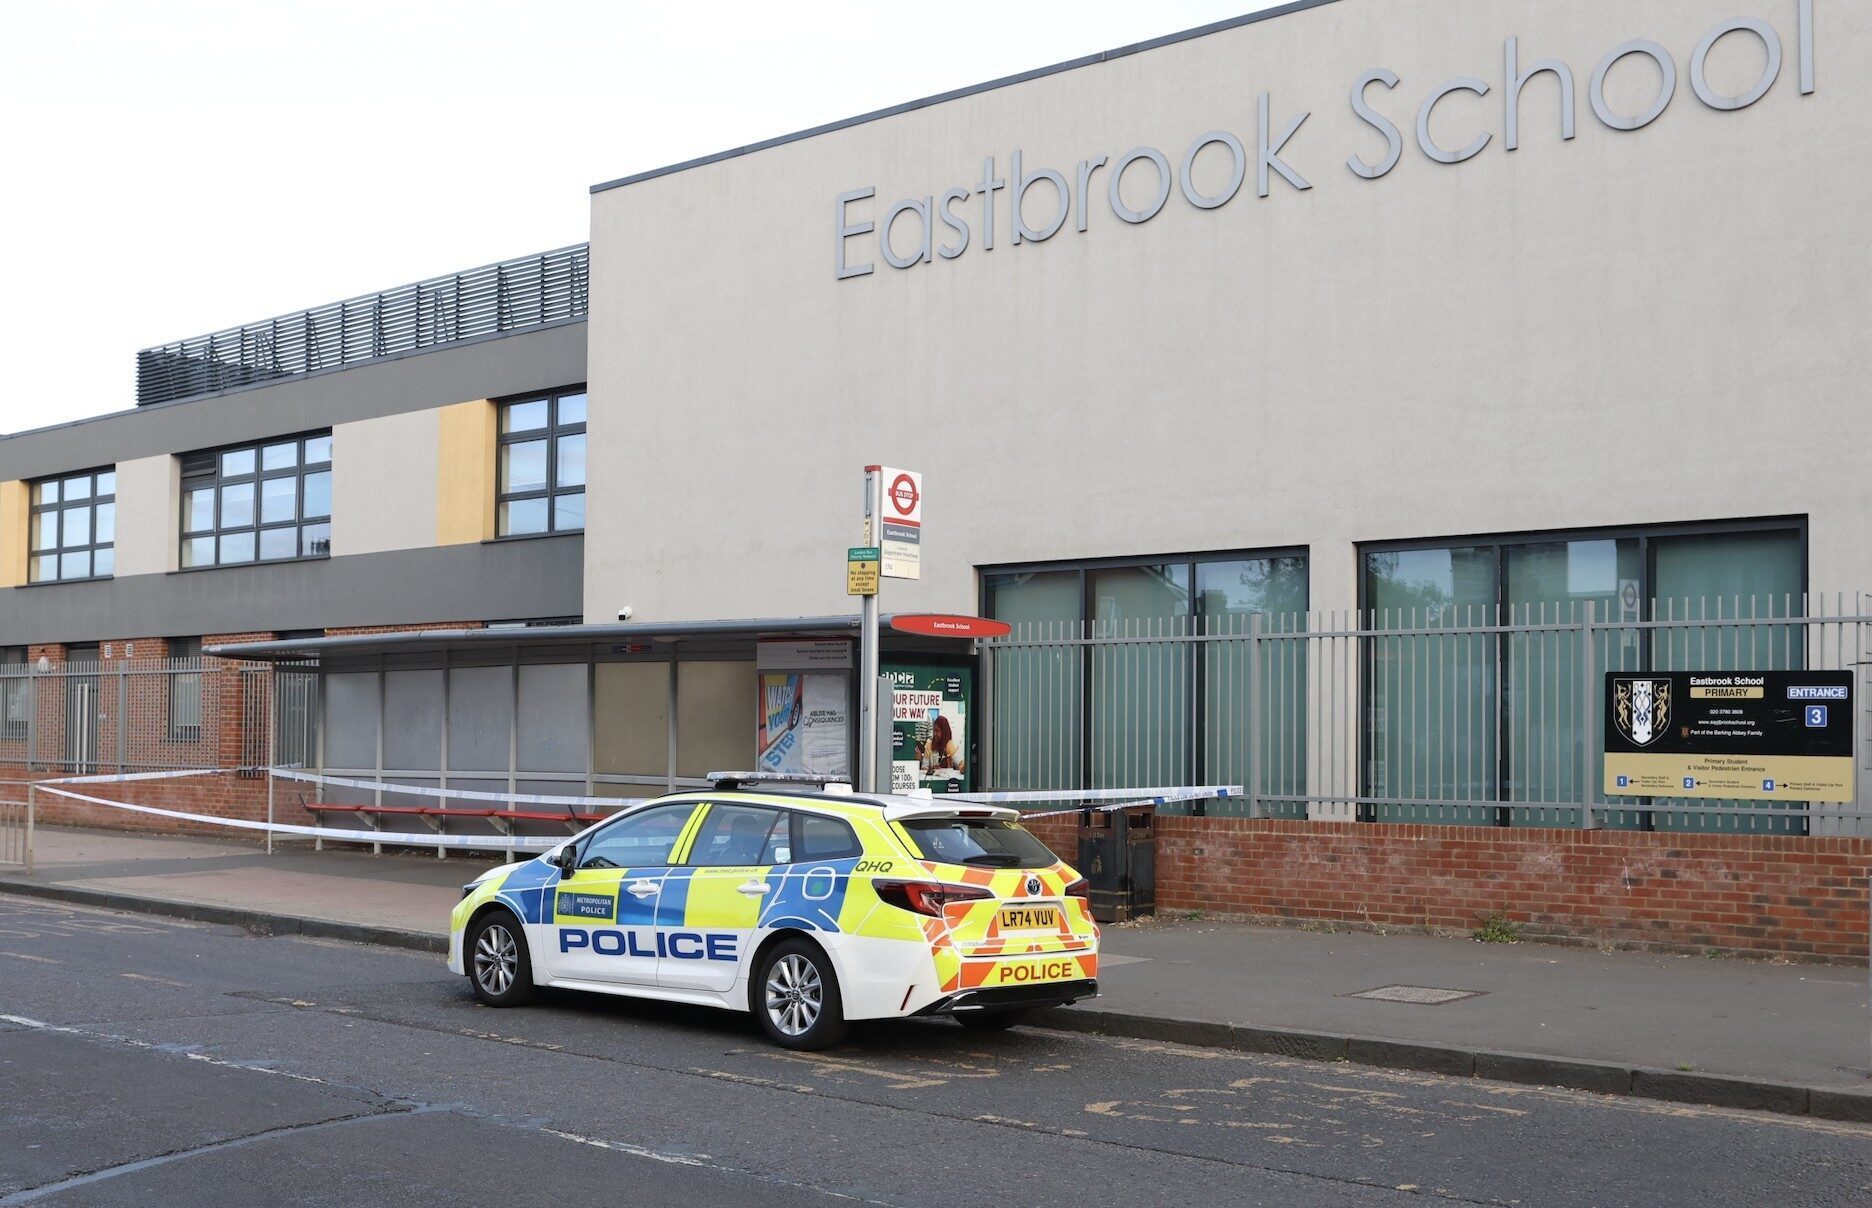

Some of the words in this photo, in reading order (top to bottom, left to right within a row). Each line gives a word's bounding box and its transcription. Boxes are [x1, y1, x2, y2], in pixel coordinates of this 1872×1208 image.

[835, 92, 1312, 280] Eastbrook
[1346, 0, 1814, 178] School
[887, 529, 905, 537] Eastbrook
[906, 531, 917, 539] School
[1690, 677, 1732, 685] Eastbrook
[1734, 677, 1764, 685] School
[767, 686, 795, 710] WATCH
[1705, 688, 1748, 696] PRIMARY
[1790, 688, 1845, 697] ENTRANCE
[893, 694, 907, 705] UR
[910, 694, 940, 706] FUTURE
[768, 704, 792, 731] YOUR
[893, 708, 907, 719] UR
[910, 708, 925, 719] WAY
[1811, 709, 1822, 724] 3
[766, 733, 795, 766] STEP
[892, 782, 916, 790] COURSES
[856, 861, 893, 873] QHQ
[576, 897, 612, 906] METROPOLITAN
[580, 907, 606, 915] POLICE
[1002, 911, 1032, 927] LR74
[1034, 910, 1054, 925] VUV
[559, 928, 738, 962] POLICE
[1000, 963, 1072, 982] POLICE
